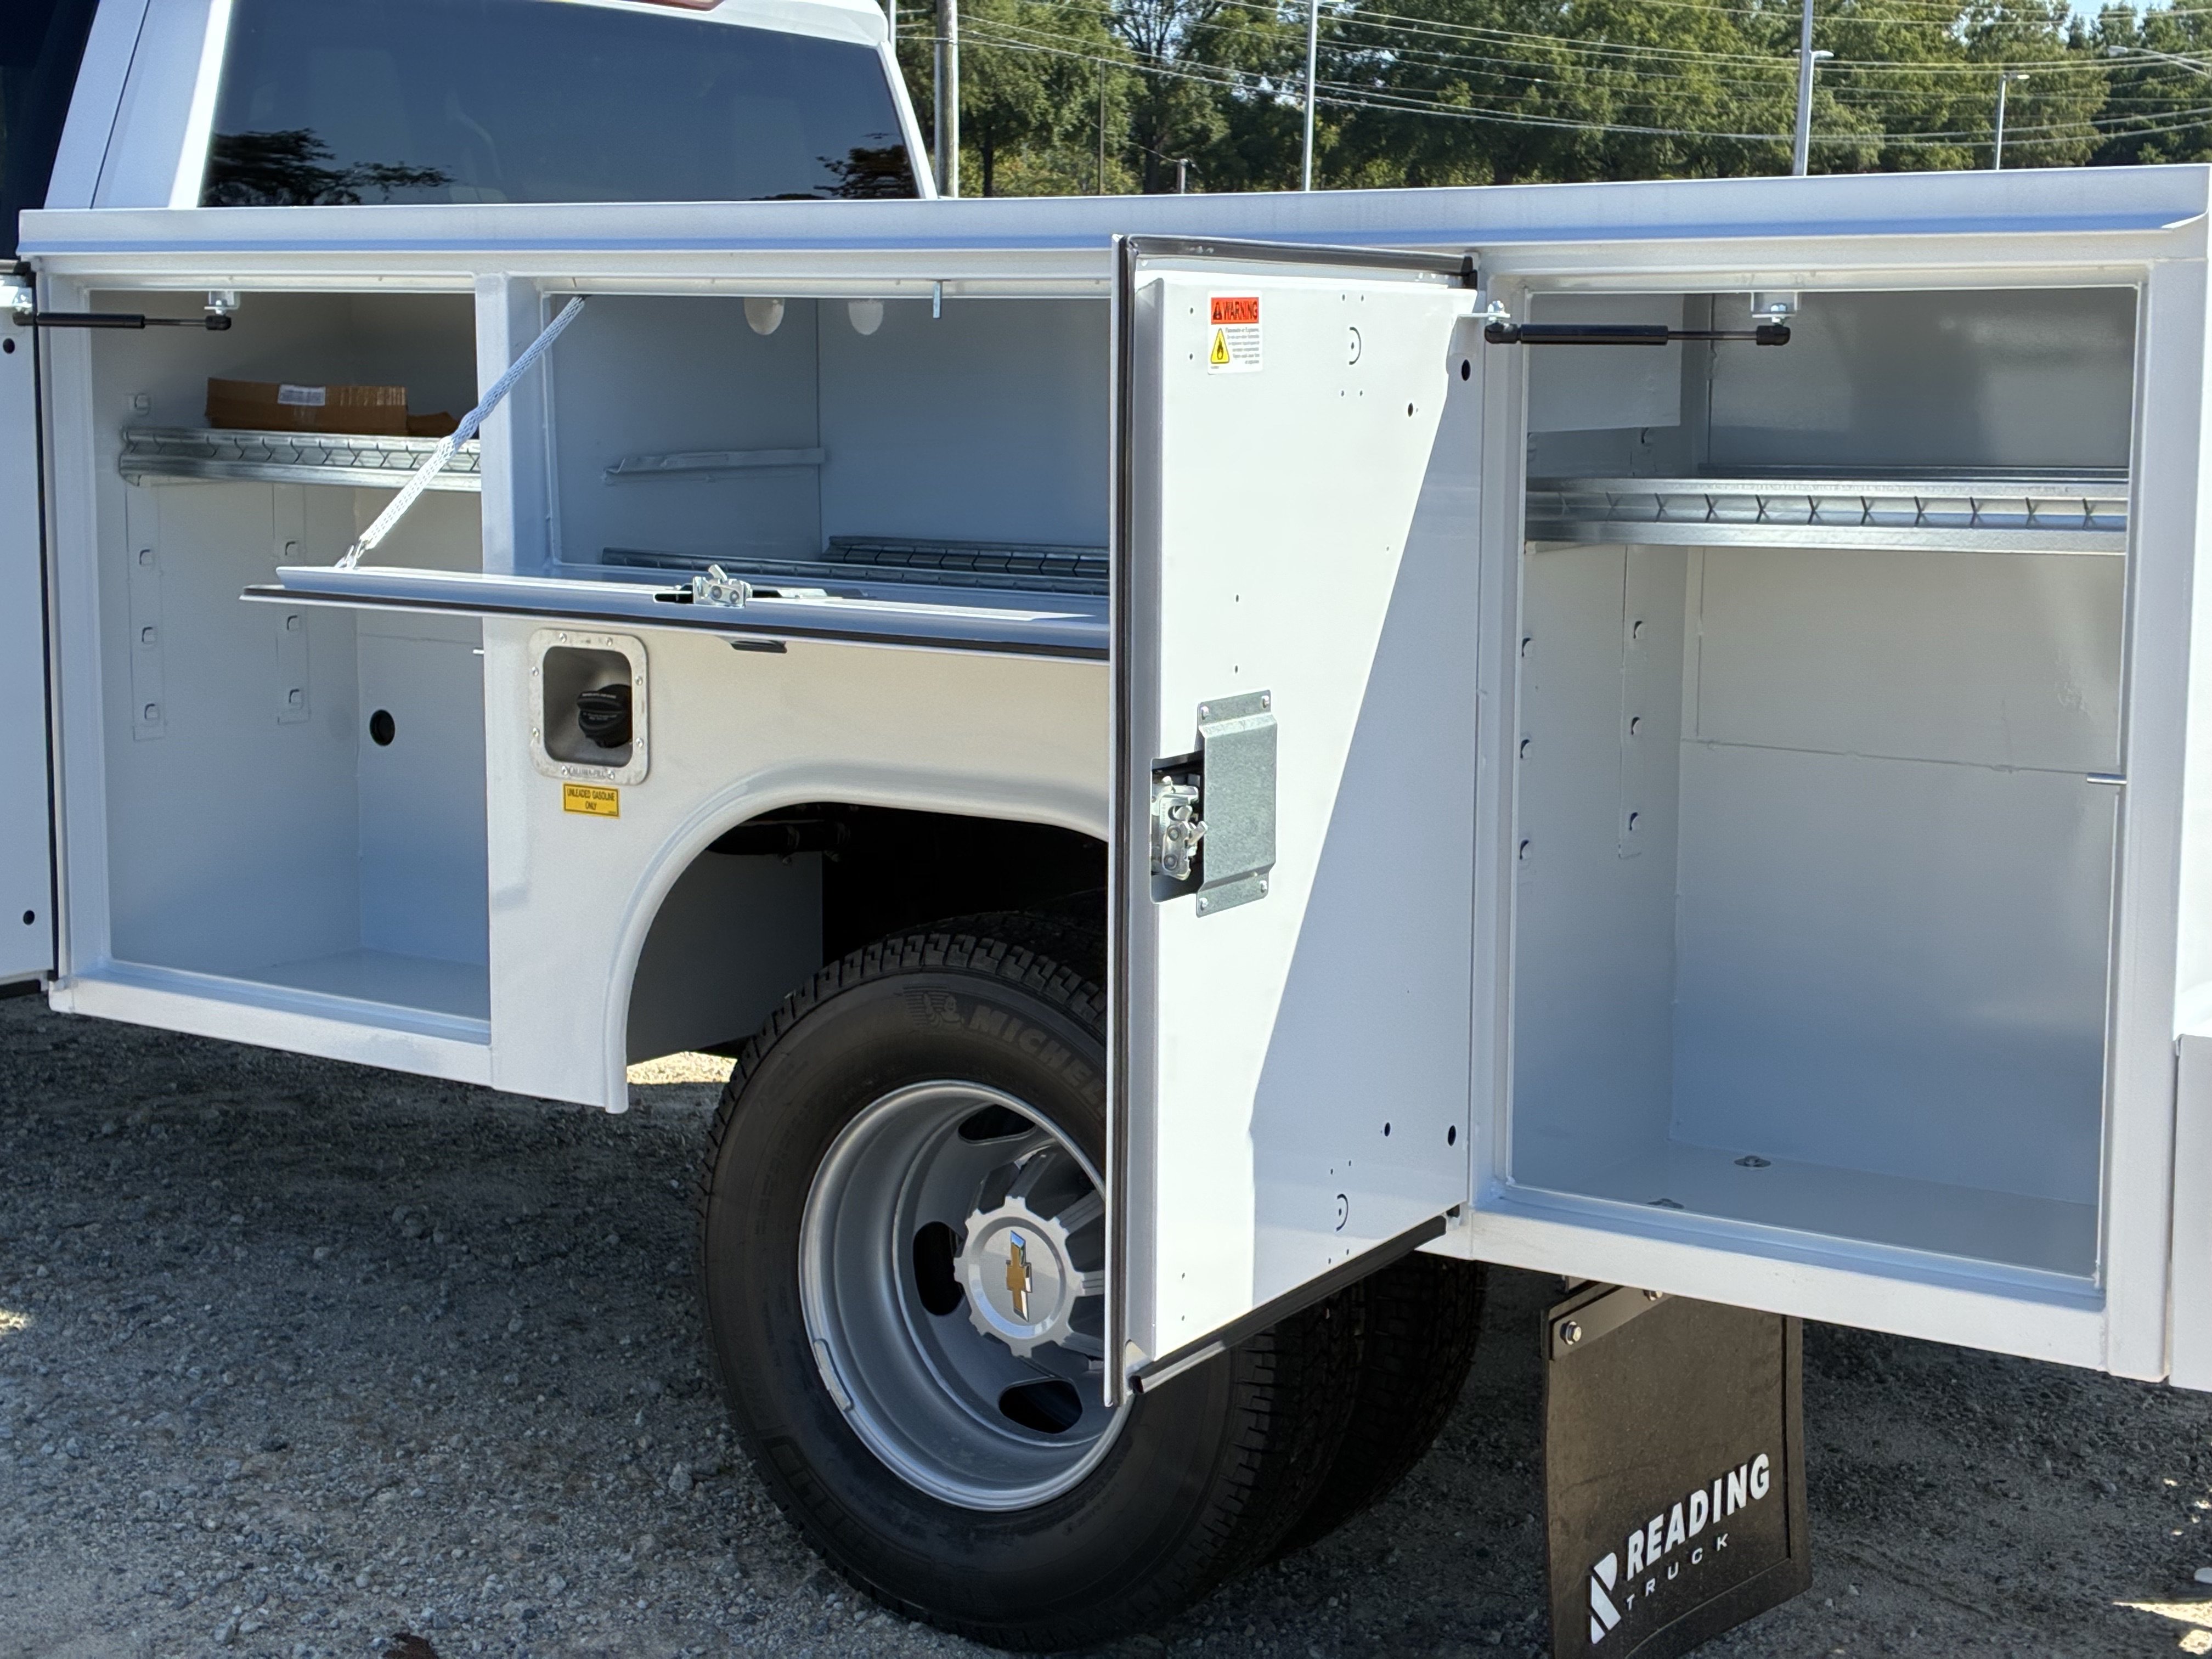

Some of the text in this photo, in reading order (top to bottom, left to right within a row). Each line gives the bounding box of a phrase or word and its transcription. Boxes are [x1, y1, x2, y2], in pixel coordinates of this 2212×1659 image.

[1223, 301, 1257, 320] WARNING
[567, 788, 615, 801] UNLEADED GASOLINE
[585, 801, 597, 810] ONLY
[1627, 1453, 1769, 1581] READING
[1626, 1533, 1729, 1611] TRUCK
